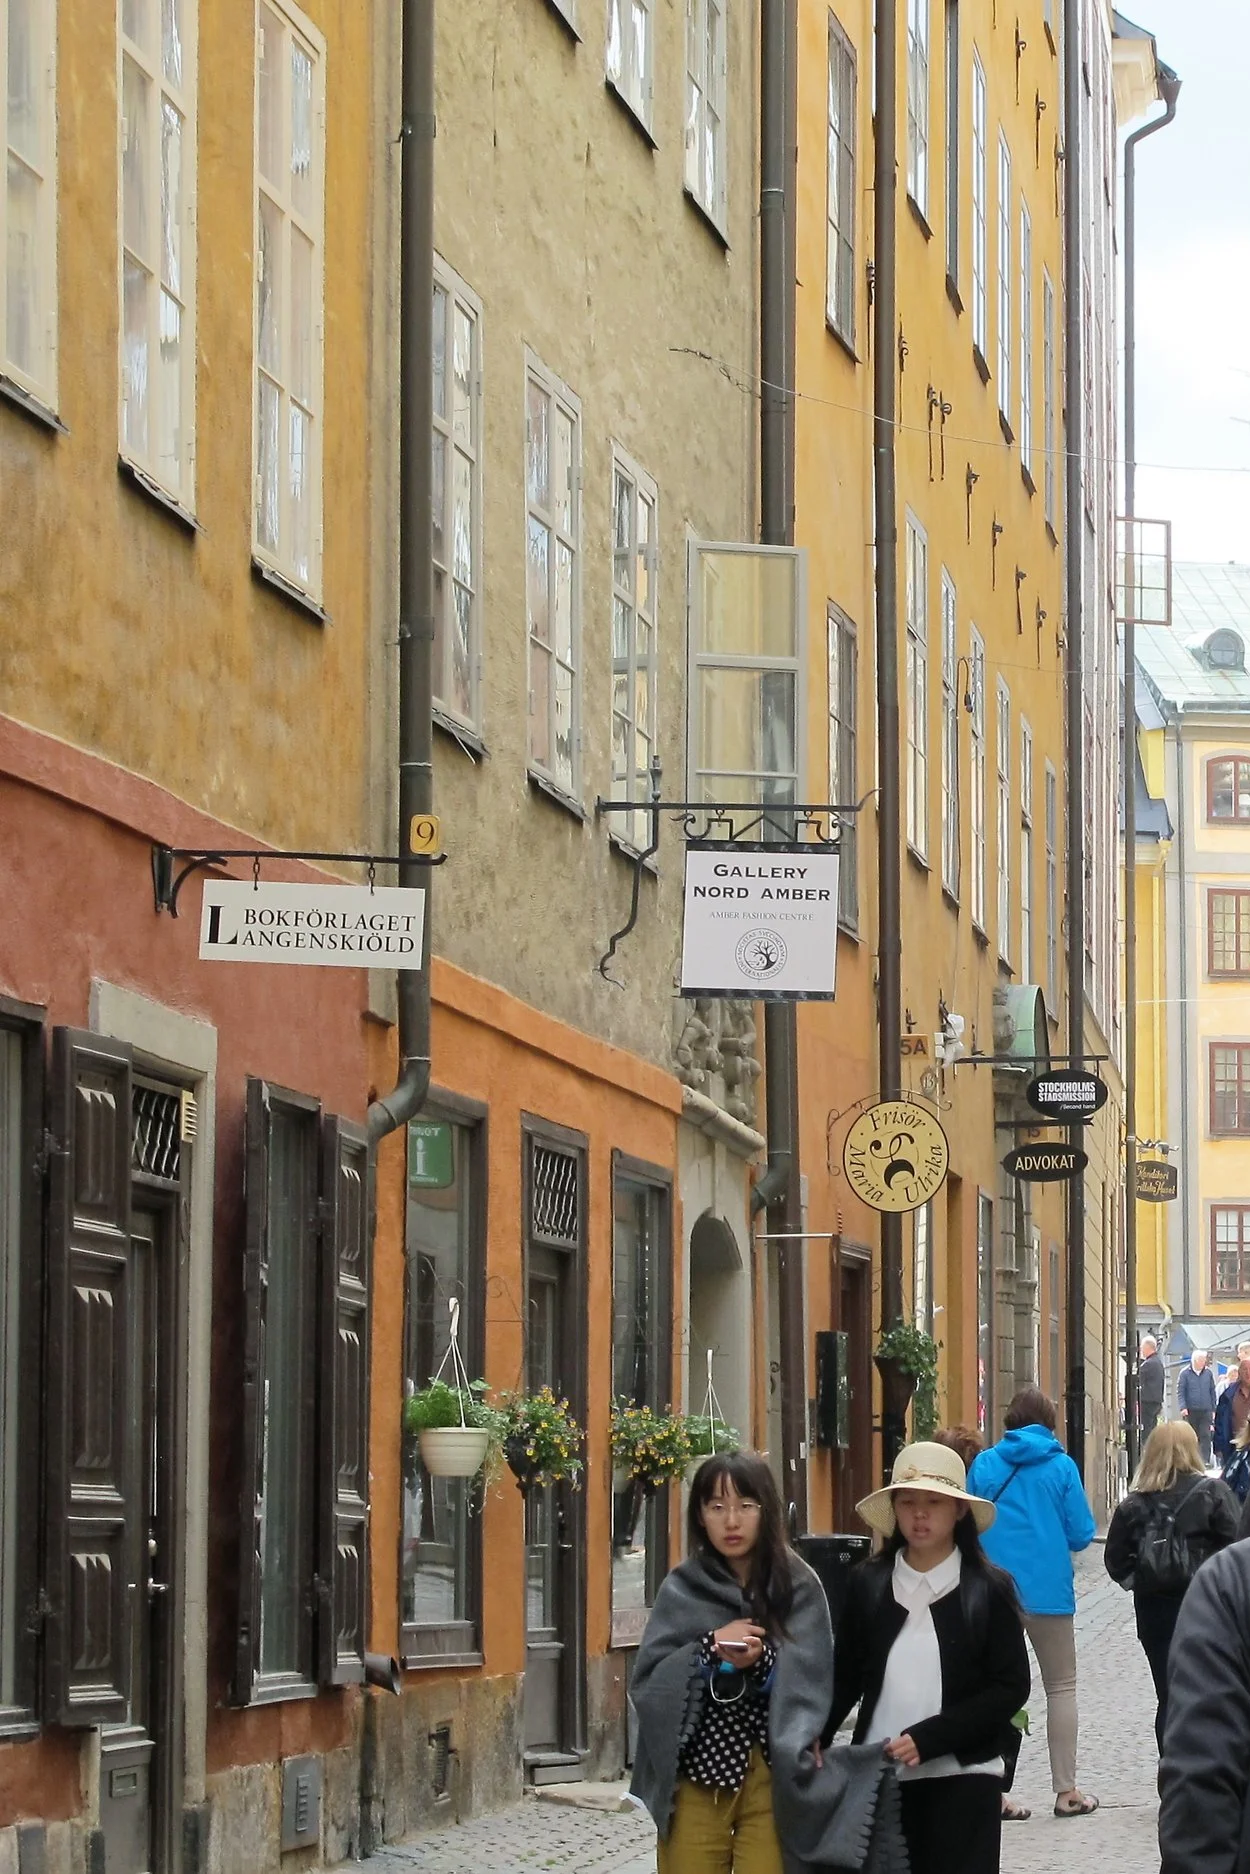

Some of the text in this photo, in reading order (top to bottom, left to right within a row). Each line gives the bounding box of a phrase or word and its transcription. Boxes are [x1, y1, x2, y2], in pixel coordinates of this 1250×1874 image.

[416, 821, 435, 848] 9
[713, 864, 808, 879] GALLERY
[693, 885, 831, 901] NORD AMBER
[244, 908, 416, 932] BOKFÖRLAGET
[709, 911, 815, 921] AMBER FASHION CENTRE
[900, 1038, 927, 1056] 5A
[1038, 1082, 1096, 1093] STOCKHOLMS
[1038, 1092, 1096, 1102] STADSMISSION
[869, 1106, 926, 1132] Frisör
[1015, 1154, 1076, 1171] ADVOKAT
[849, 1144, 884, 1202] Maria
[904, 1144, 943, 1203] Ulrika
